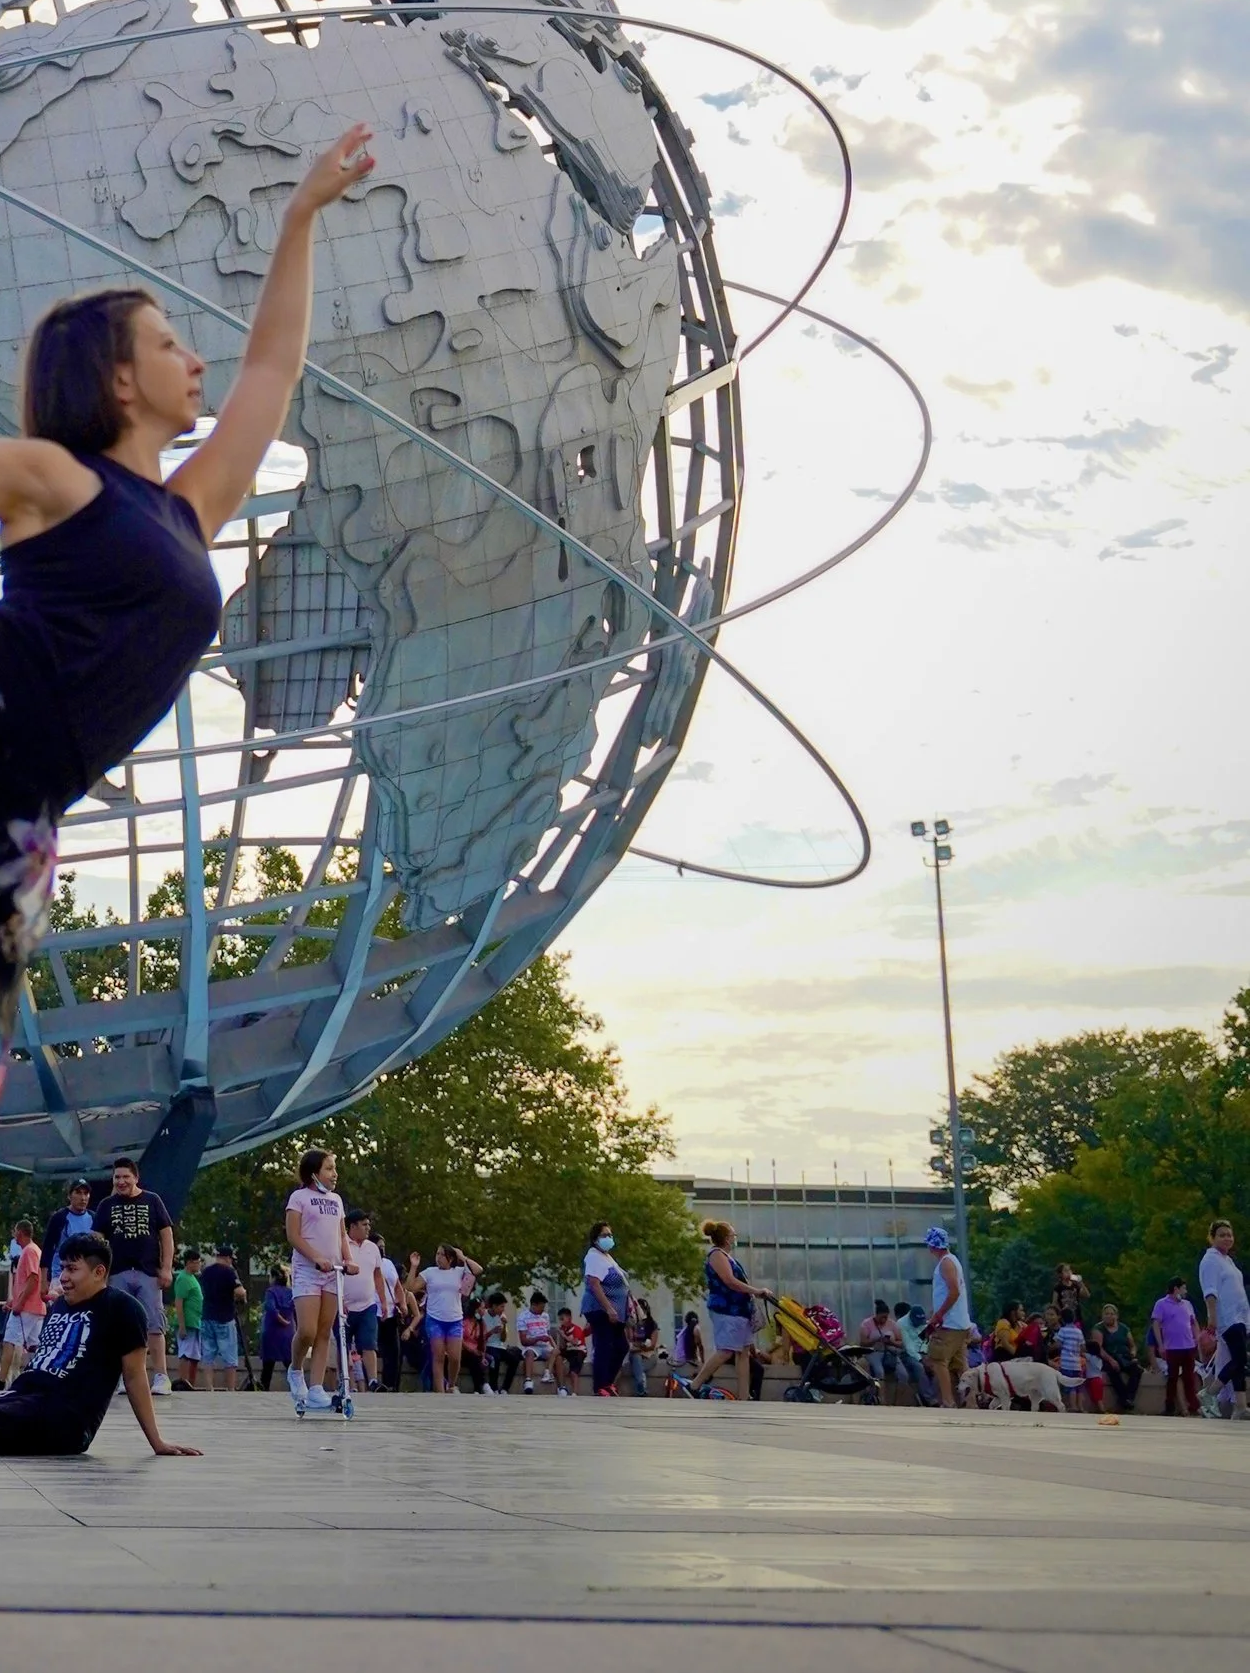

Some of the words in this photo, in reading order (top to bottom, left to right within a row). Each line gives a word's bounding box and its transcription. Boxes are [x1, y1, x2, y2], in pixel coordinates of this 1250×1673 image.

[123, 1204, 137, 1238] STRIPE
[137, 1204, 150, 1236] THREE
[47, 1310, 93, 1324] BACK
